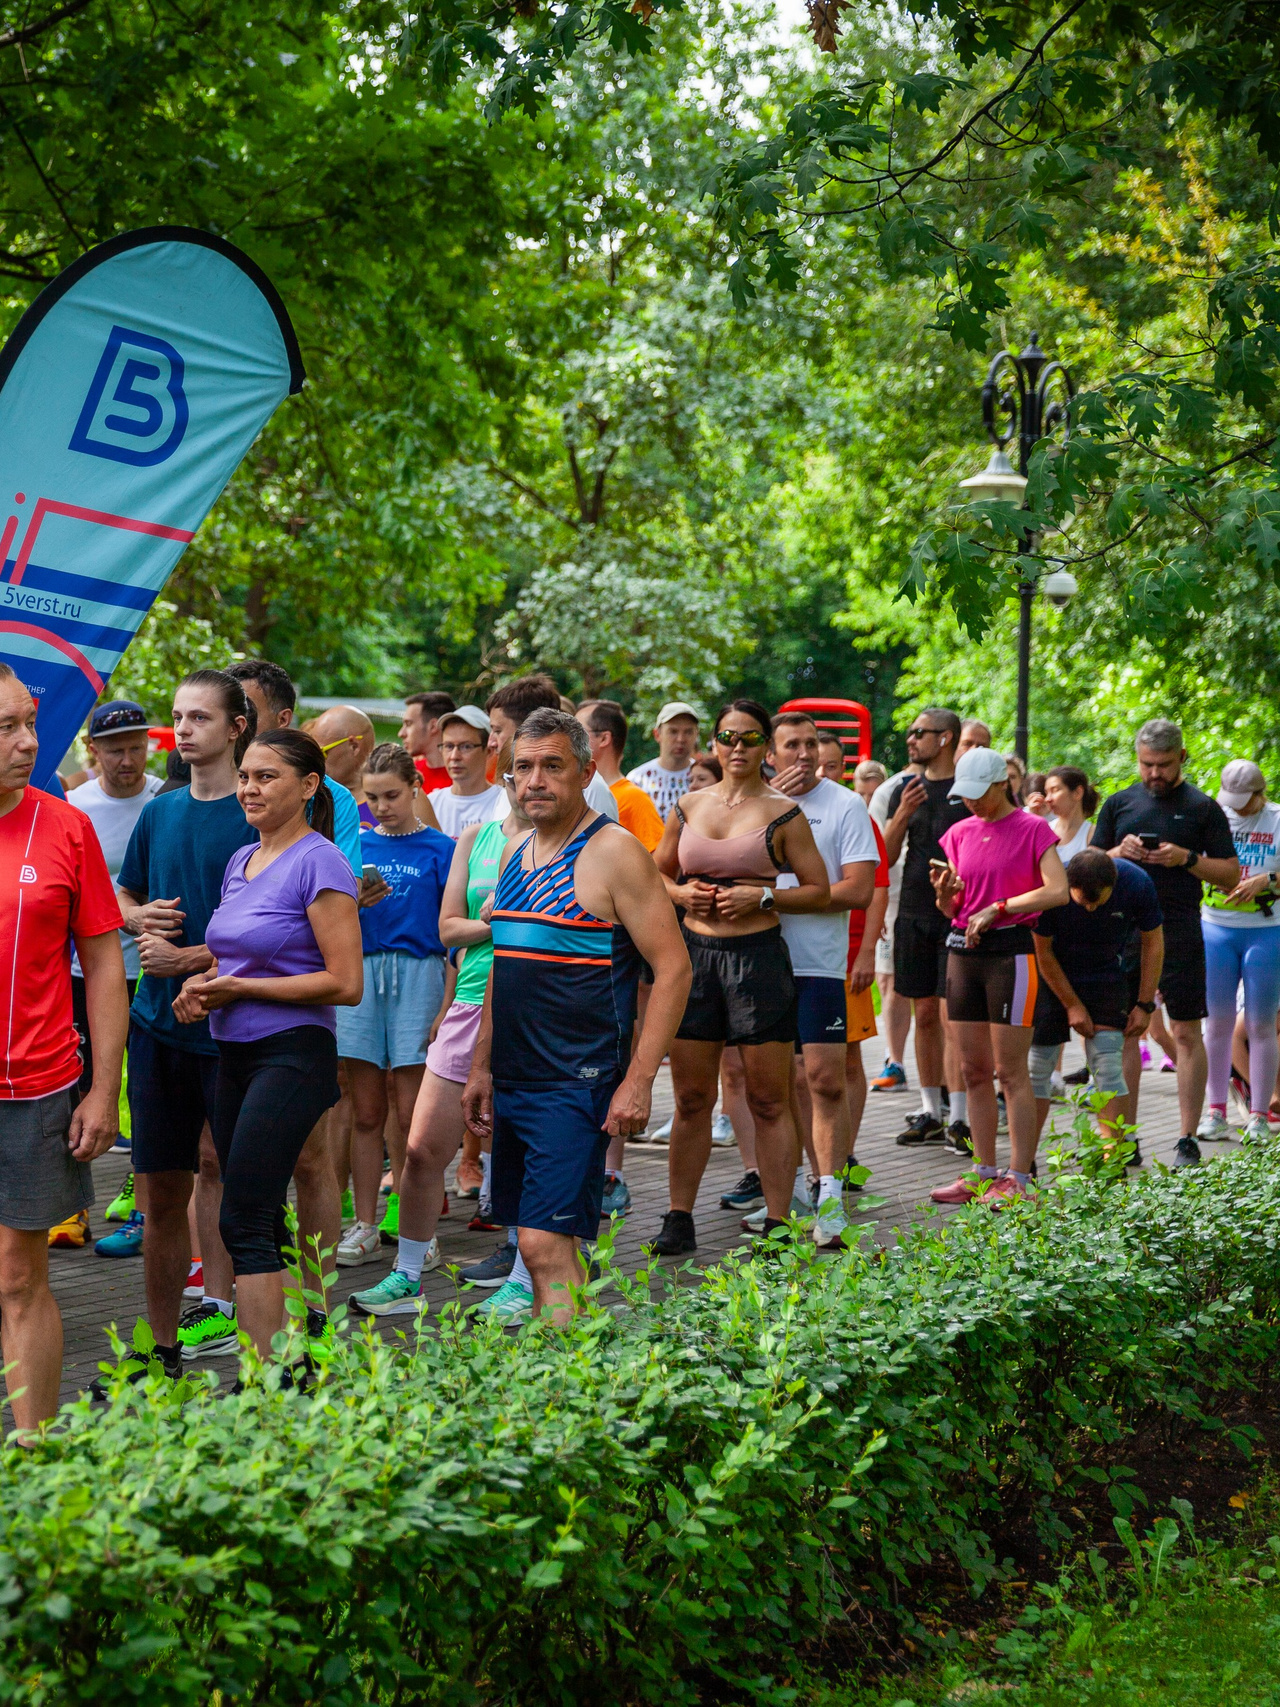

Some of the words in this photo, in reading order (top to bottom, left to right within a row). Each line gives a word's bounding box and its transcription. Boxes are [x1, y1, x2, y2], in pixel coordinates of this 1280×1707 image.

[3, 586, 82, 619] 5verst.ru
[24, 684, 46, 694] ТНЕР
[395, 864, 421, 878] VIBE
